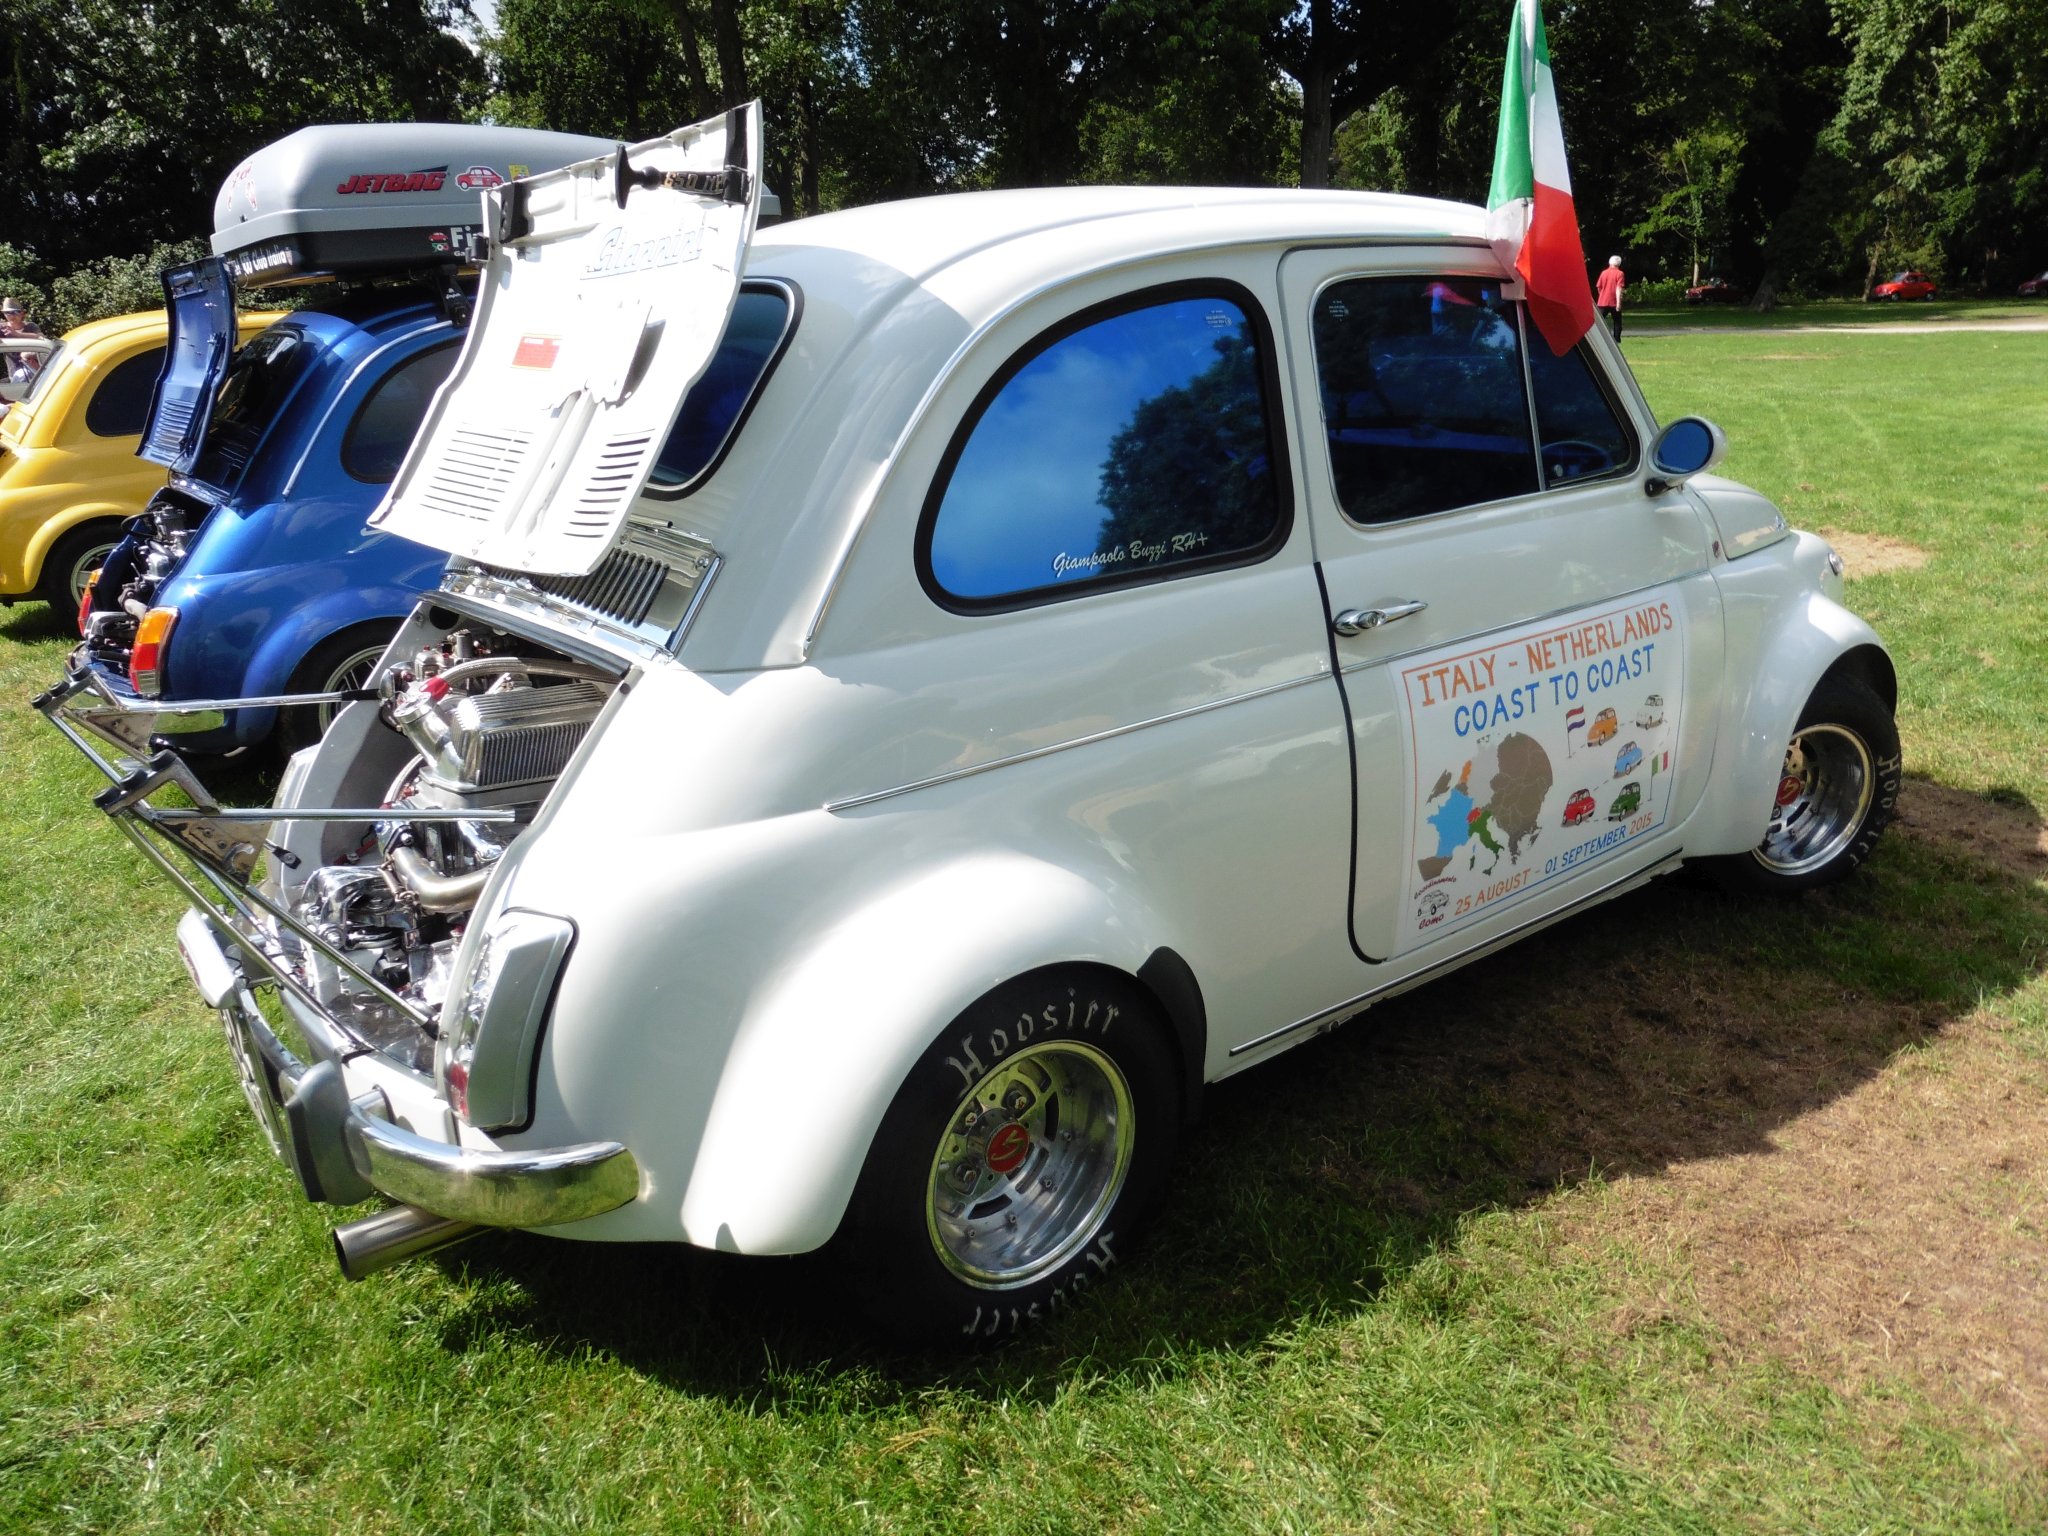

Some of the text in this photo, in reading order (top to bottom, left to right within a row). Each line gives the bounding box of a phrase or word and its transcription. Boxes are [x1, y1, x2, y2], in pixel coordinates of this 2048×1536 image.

[336, 172, 447, 194] JETBAG
[664, 171, 699, 189] 650
[450, 225, 473, 248] Fi
[1052, 546, 1126, 578] Giampaolo
[1129, 540, 1167, 561] Buzzi
[1417, 654, 1496, 707] ITALY
[1525, 602, 1673, 674] NETHERLANDS
[1454, 643, 1655, 737] COAST TO COAST
[1454, 895, 1472, 916] 25
[1474, 868, 1532, 907] AUGUST
[1561, 825, 1627, 867] SEPTEMBER
[1629, 812, 1653, 835] 2015
[1418, 913, 1445, 930] Como
